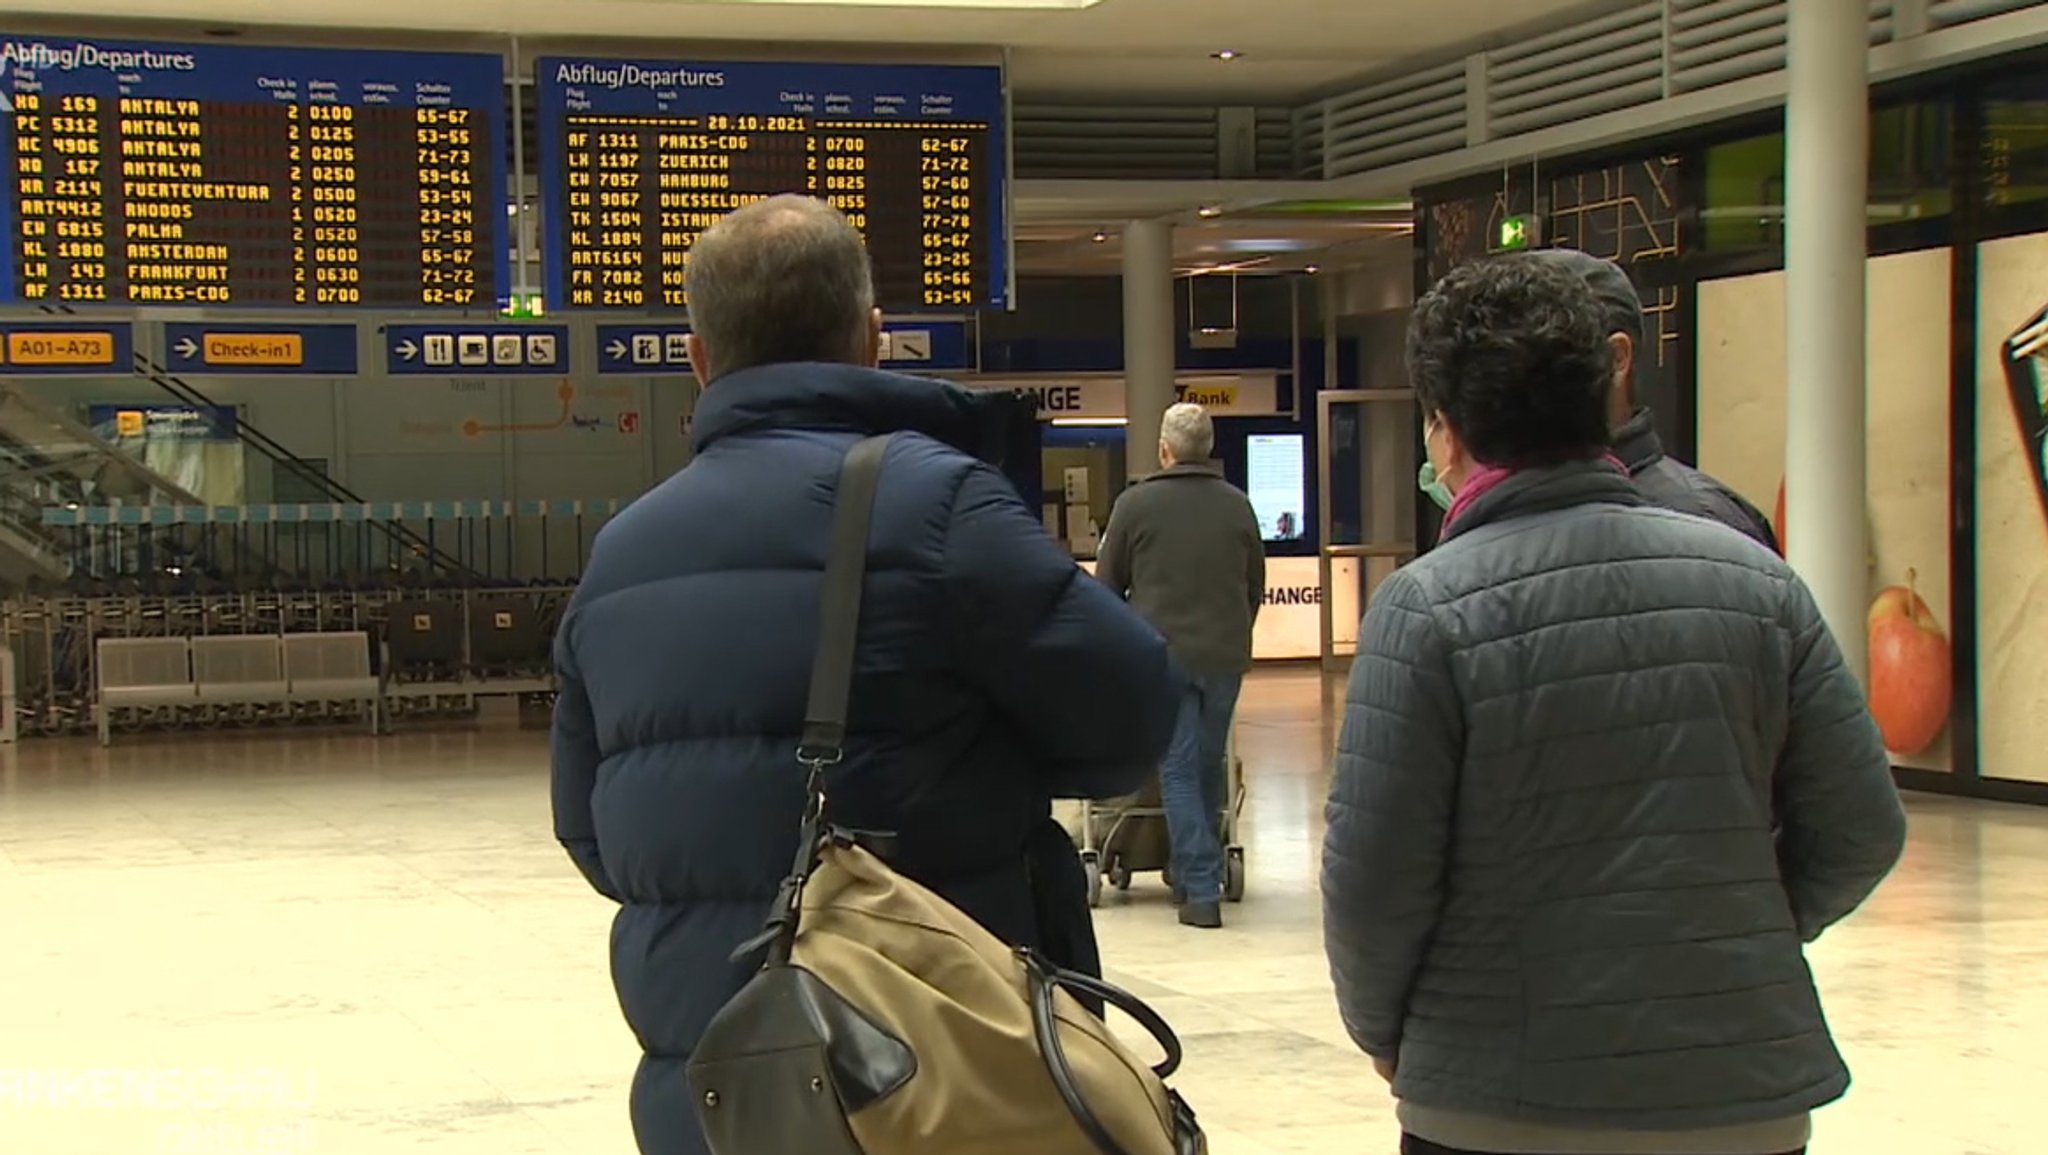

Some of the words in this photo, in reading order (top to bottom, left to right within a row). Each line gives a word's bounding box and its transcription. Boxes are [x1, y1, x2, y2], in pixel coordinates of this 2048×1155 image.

[2, 43, 195, 72] Abflug/Departures
[556, 63, 725, 88] Abflug/Departures
[416, 95, 450, 106] Counter
[780, 92, 803, 102] Check
[921, 95, 953, 104] Schalter
[63, 96, 97, 112] 169
[120, 98, 199, 116] ANTALYA
[288, 105, 298, 119] 2
[310, 106, 352, 121] 0100
[417, 109, 468, 124] 65-67
[921, 106, 952, 115] Counter
[17, 115, 40, 131] PC
[52, 117, 98, 133] 5312
[121, 119, 200, 136] ANTALYA
[289, 125, 299, 140] 2
[311, 126, 353, 141] 0125
[417, 129, 469, 144] 53-55
[708, 116, 805, 131] 28.10.2021
[568, 133, 588, 147] AF
[599, 133, 638, 148] 1311
[659, 135, 748, 149] PARIS-CDG
[806, 137, 815, 151] 2
[826, 137, 864, 151] 0700
[922, 138, 968, 152] 62-67
[122, 140, 201, 157] ANTALYA
[290, 145, 300, 160] 2
[311, 146, 354, 161] 0205
[418, 149, 470, 164] 71-73
[600, 153, 639, 168] 1197
[660, 154, 729, 169] ZUERICH
[807, 157, 816, 170] 2
[826, 157, 864, 170] 0820
[922, 157, 969, 171] 71-72
[66, 160, 100, 175] 167
[123, 161, 202, 177] ANTALYA
[290, 166, 301, 180] 2
[312, 167, 355, 182] 0250
[419, 169, 470, 184] 59-61
[600, 173, 639, 187] 7057
[660, 174, 729, 188] HAMBURG
[807, 176, 816, 189] 2
[827, 176, 865, 190] 0825
[922, 176, 969, 190] 57-60
[55, 180, 101, 196] 2114
[124, 182, 269, 200] FUERTEVENTURA
[292, 186, 302, 201] 2
[313, 187, 356, 202] 0500
[420, 189, 472, 204] 53-54
[600, 192, 640, 206] 9067
[923, 195, 969, 209] 57-60
[21, 199, 102, 216] ART4412
[125, 202, 192, 218] RHODOS
[293, 207, 302, 221] 1
[314, 207, 356, 222] 0520
[420, 209, 472, 224] 23-24
[571, 211, 591, 225] TK
[602, 211, 641, 226] 1504
[923, 214, 970, 228] 77-78
[57, 221, 103, 237] 6815
[126, 223, 182, 239] PALMA
[293, 227, 303, 241] 2
[315, 228, 357, 241] 0520
[421, 229, 472, 243] 57-58
[571, 231, 591, 245] KL
[602, 232, 641, 246] 1884
[923, 233, 970, 247] 65-67
[23, 241, 46, 256] KL
[58, 242, 104, 257] 1880
[127, 244, 227, 260] AMSTERDAM
[294, 247, 304, 261] 2
[316, 247, 358, 262] 0600
[422, 249, 472, 263] 65-67
[572, 251, 642, 265] ART6164
[924, 252, 970, 266] 23-25
[71, 263, 105, 278] 143
[128, 264, 228, 280] FRANKFURT
[295, 267, 304, 281] 2
[316, 267, 358, 282] 0630
[422, 269, 473, 283] 71-72
[572, 270, 592, 284] FR
[603, 270, 642, 284] 7082
[924, 271, 970, 285] 65-66
[25, 283, 47, 297] AF
[60, 284, 105, 299] 1311
[129, 285, 229, 301] PARIS-CDG
[295, 287, 305, 302] 2
[317, 288, 359, 302] 0700
[423, 288, 474, 303] 62-67
[603, 290, 643, 304] 2140
[924, 290, 971, 304] 53-54
[19, 341, 101, 356] A01-A73
[1188, 389, 1231, 405] Bank
